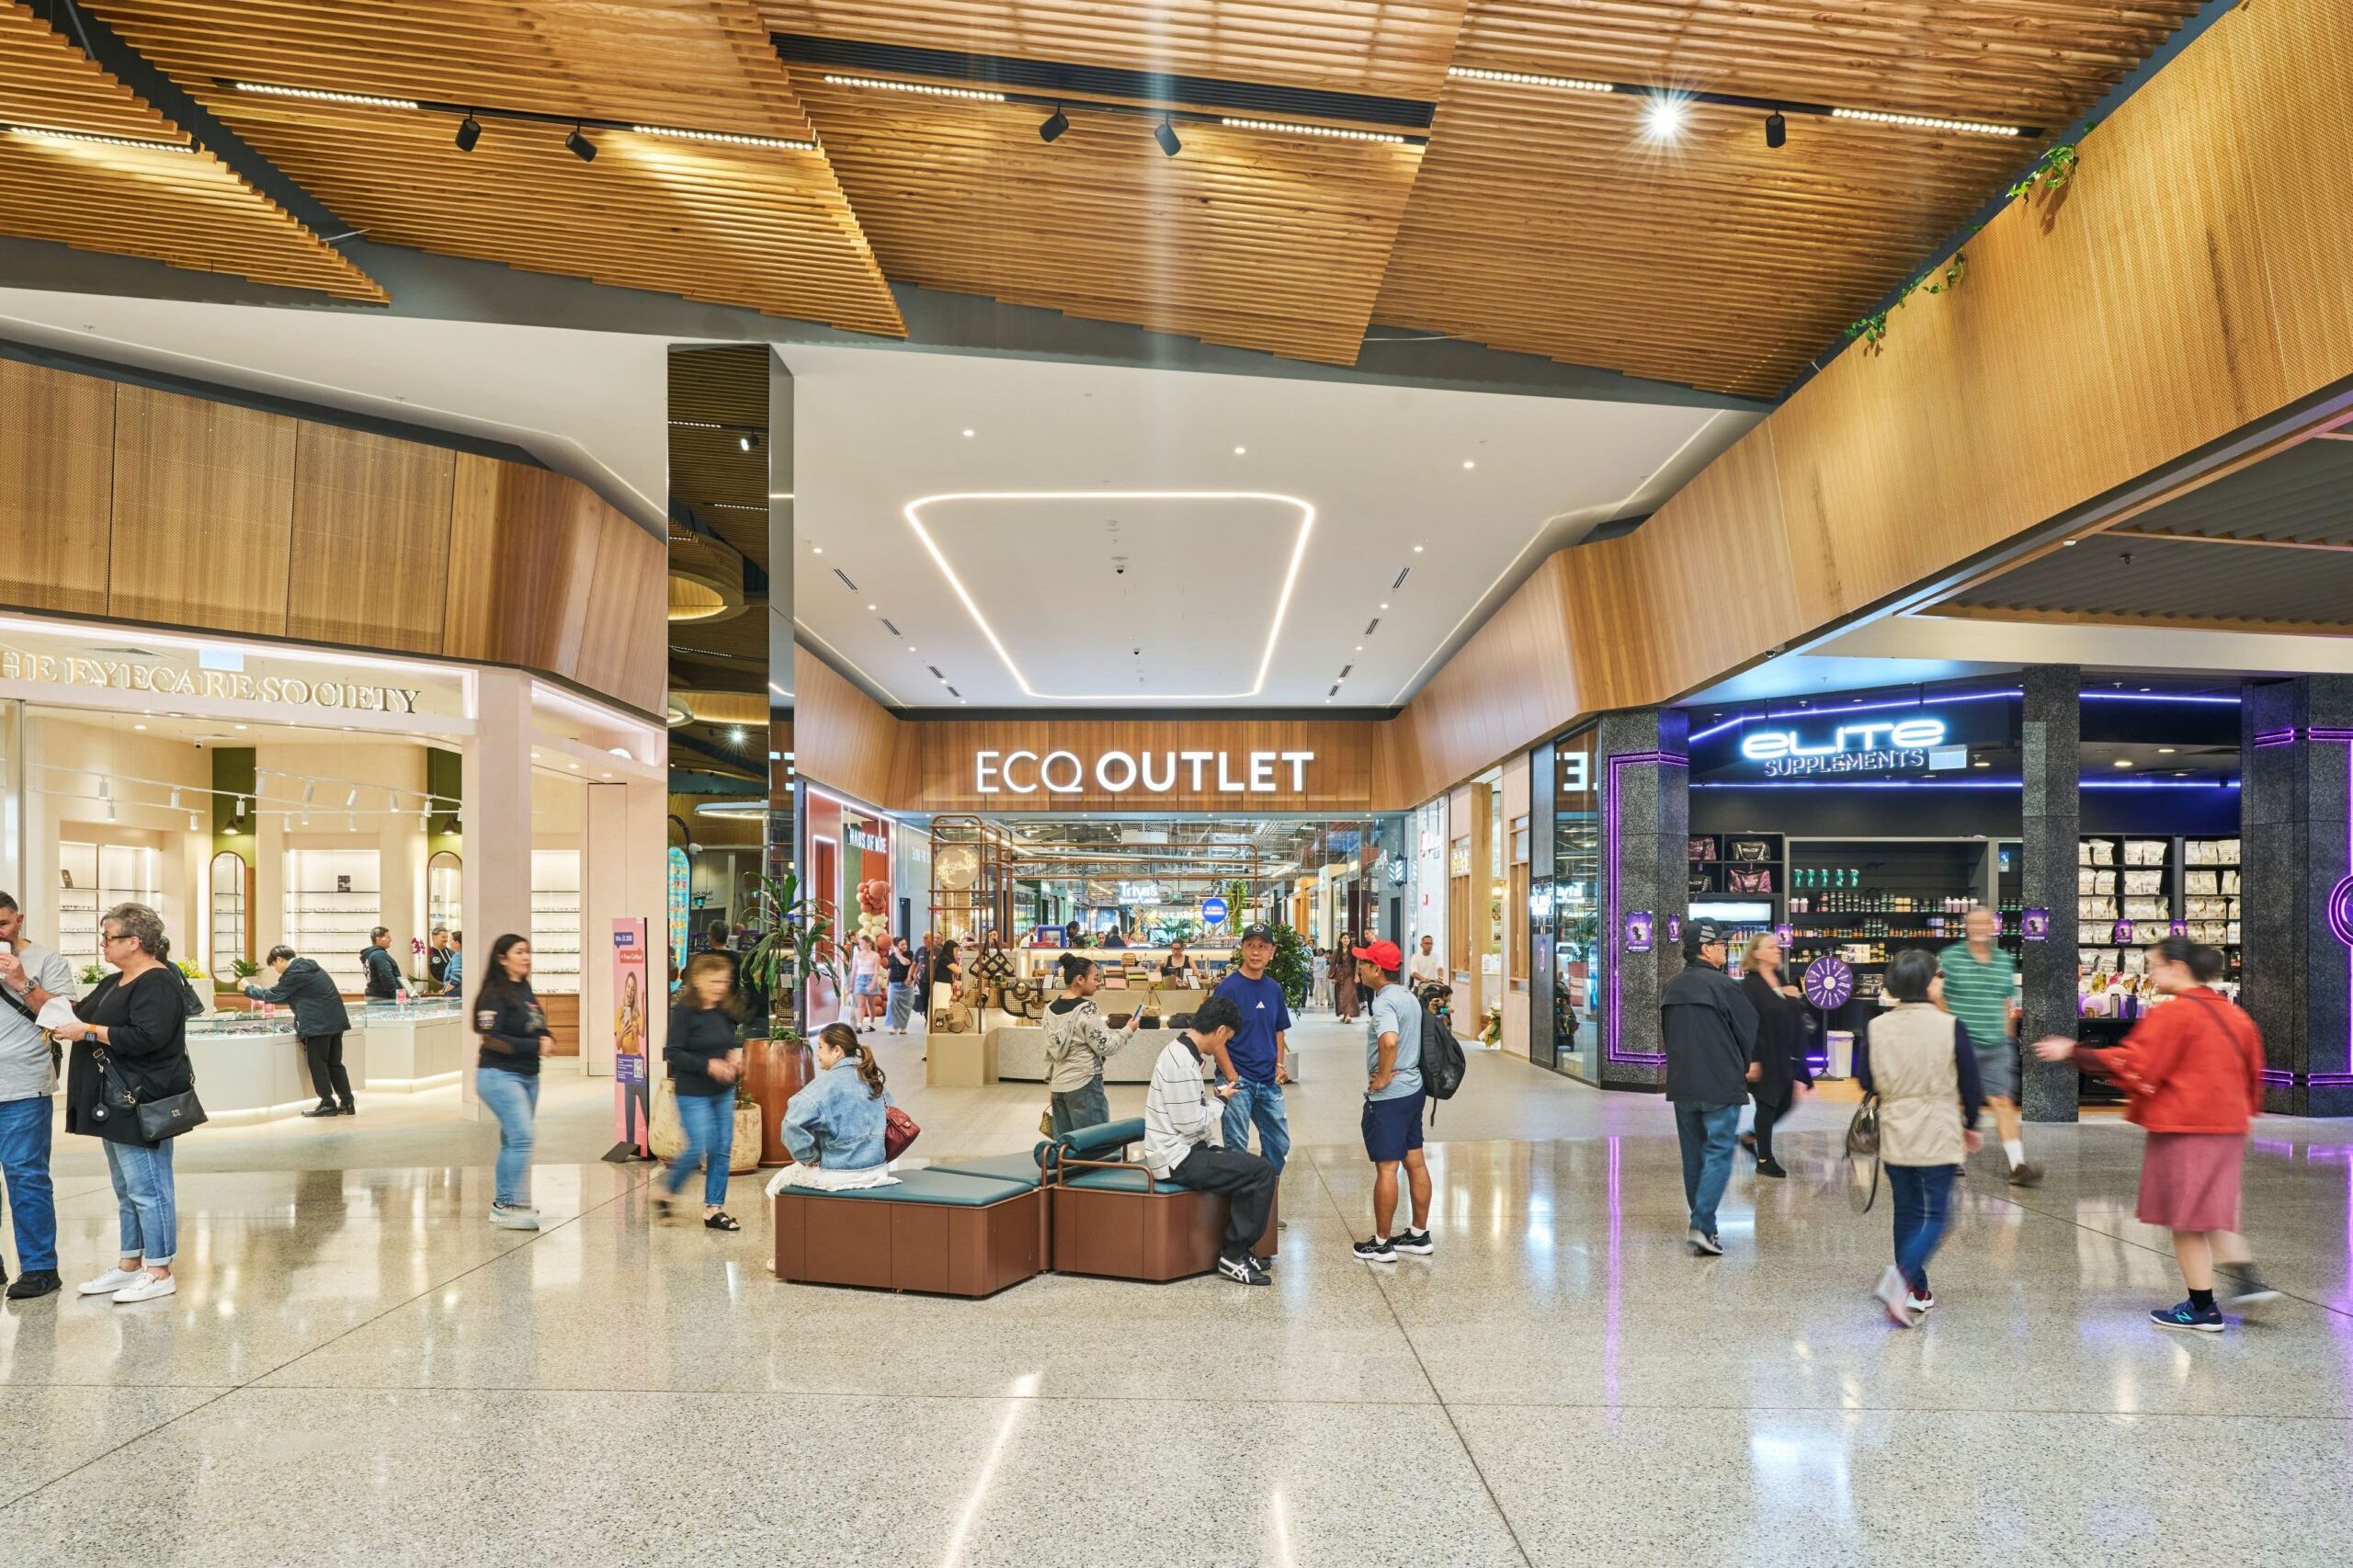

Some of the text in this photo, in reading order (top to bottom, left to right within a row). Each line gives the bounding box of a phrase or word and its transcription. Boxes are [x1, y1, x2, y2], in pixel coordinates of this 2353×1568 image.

[64, 656, 256, 699] EYECARE
[256, 676, 422, 715] SOCIETY
[976, 750, 1314, 793] ECQ OUTLET
[1764, 747, 1925, 777] SUPPLEMENTS
[849, 828, 865, 847] HAUS
[867, 834, 874, 850] OF
